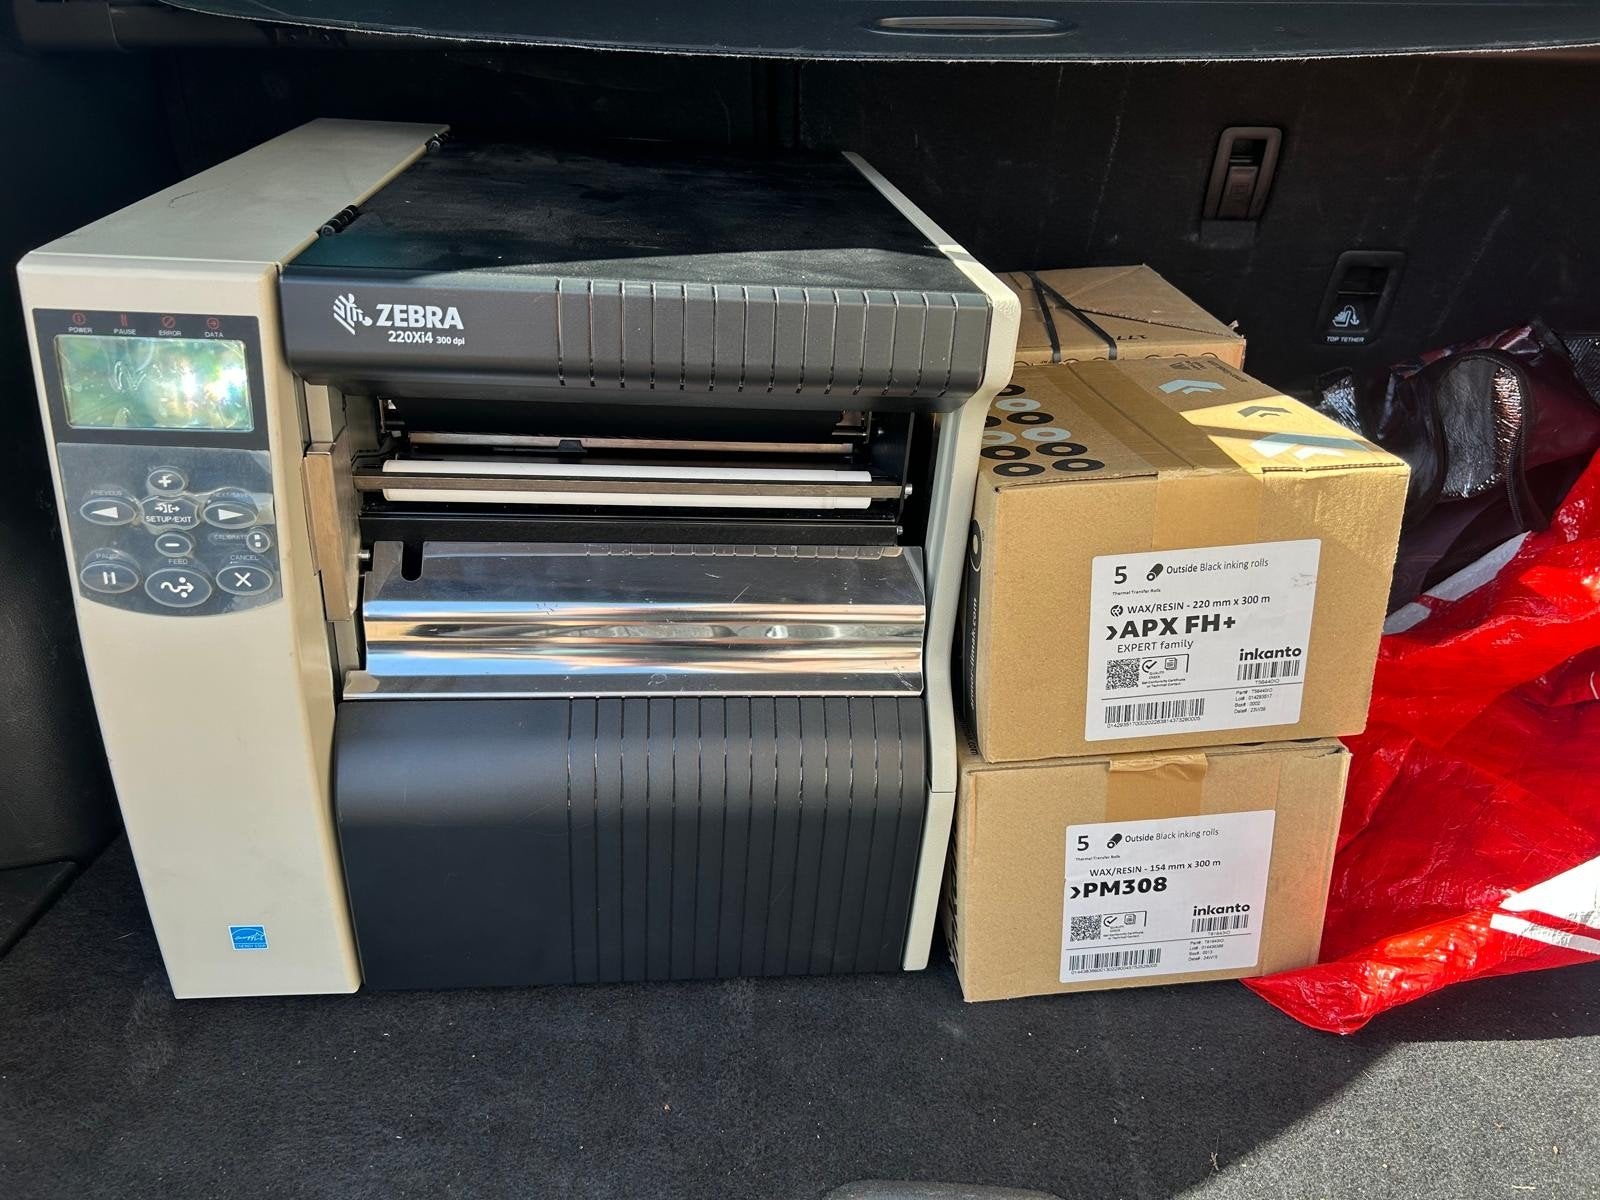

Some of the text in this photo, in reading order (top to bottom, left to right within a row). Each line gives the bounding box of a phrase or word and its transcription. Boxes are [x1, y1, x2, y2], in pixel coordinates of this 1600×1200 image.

[375, 303, 464, 330] ZEBRA
[68, 326, 93, 334] POWER
[113, 328, 136, 336] PAUSE
[387, 330, 465, 346] 220Xi4 300 dpi
[145, 516, 192, 524] SETUP/EXIT
[168, 558, 188, 566] FEED
[1114, 558, 1268, 584] 5 Outside Black inking rolls
[1127, 601, 1184, 615] WAX/RESIN
[1192, 599, 1210, 610] 220
[1212, 600, 1231, 608] mm
[1233, 598, 1240, 606] x
[1242, 596, 1259, 606] 300
[1261, 596, 1270, 604] m
[1185, 613, 1236, 634] FH+
[1117, 639, 1194, 654] EXPERT family
[1240, 646, 1302, 662] inkanto
[1076, 828, 1219, 852] 5 Outside Black inking rolls
[1089, 865, 1142, 878] WAX/RESIN
[1150, 862, 1166, 872] 154
[1168, 863, 1185, 871] mm
[1194, 859, 1210, 868] 300
[1192, 903, 1250, 916] inkanto
